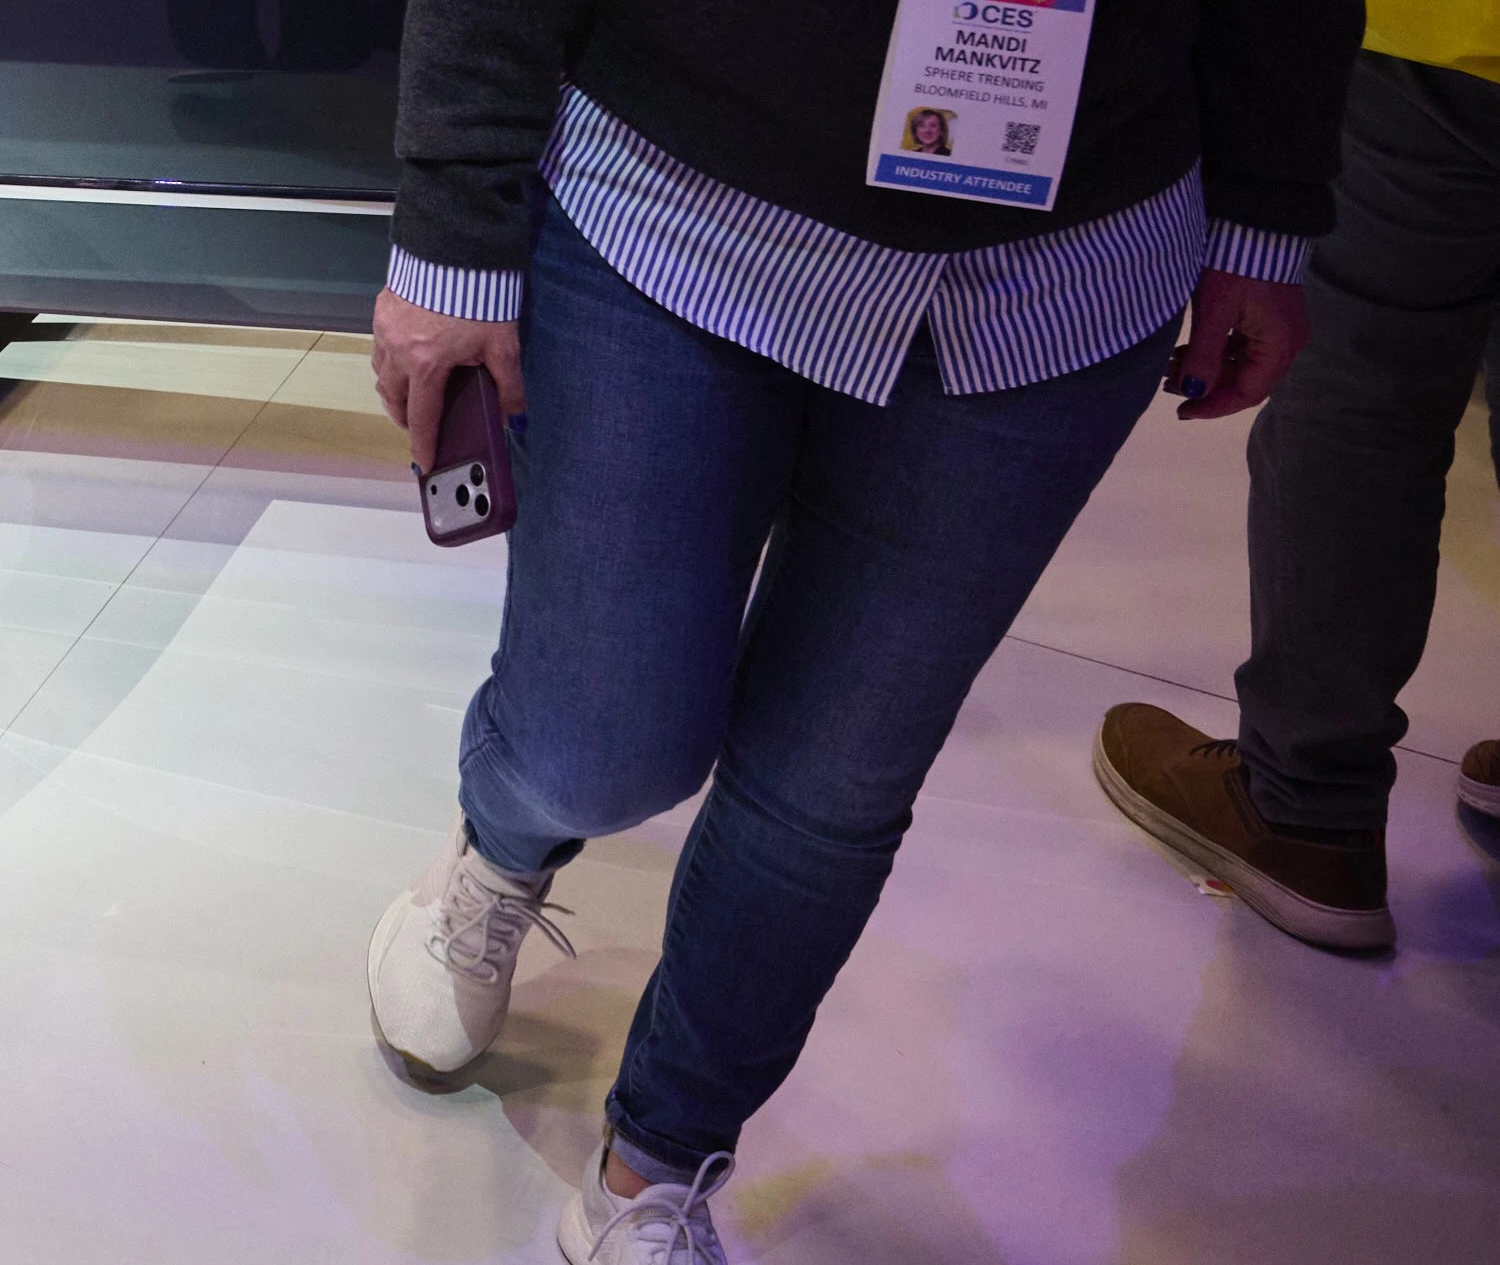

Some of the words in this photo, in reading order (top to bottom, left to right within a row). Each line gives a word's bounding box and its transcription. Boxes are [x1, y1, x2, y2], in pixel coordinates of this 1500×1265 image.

[981, 5, 1034, 28] CES
[955, 30, 1027, 53] MANDI
[935, 46, 1041, 74] MANKVITZ
[924, 66, 974, 83] SPHERE
[978, 73, 1045, 92] TRENDING
[914, 83, 991, 103] BLOOMFIELD
[994, 94, 1028, 109] HILLS,
[1031, 99, 1048, 111] MI
[895, 166, 963, 183] INDUSTRY
[963, 175, 1033, 194] ATTENDEE
